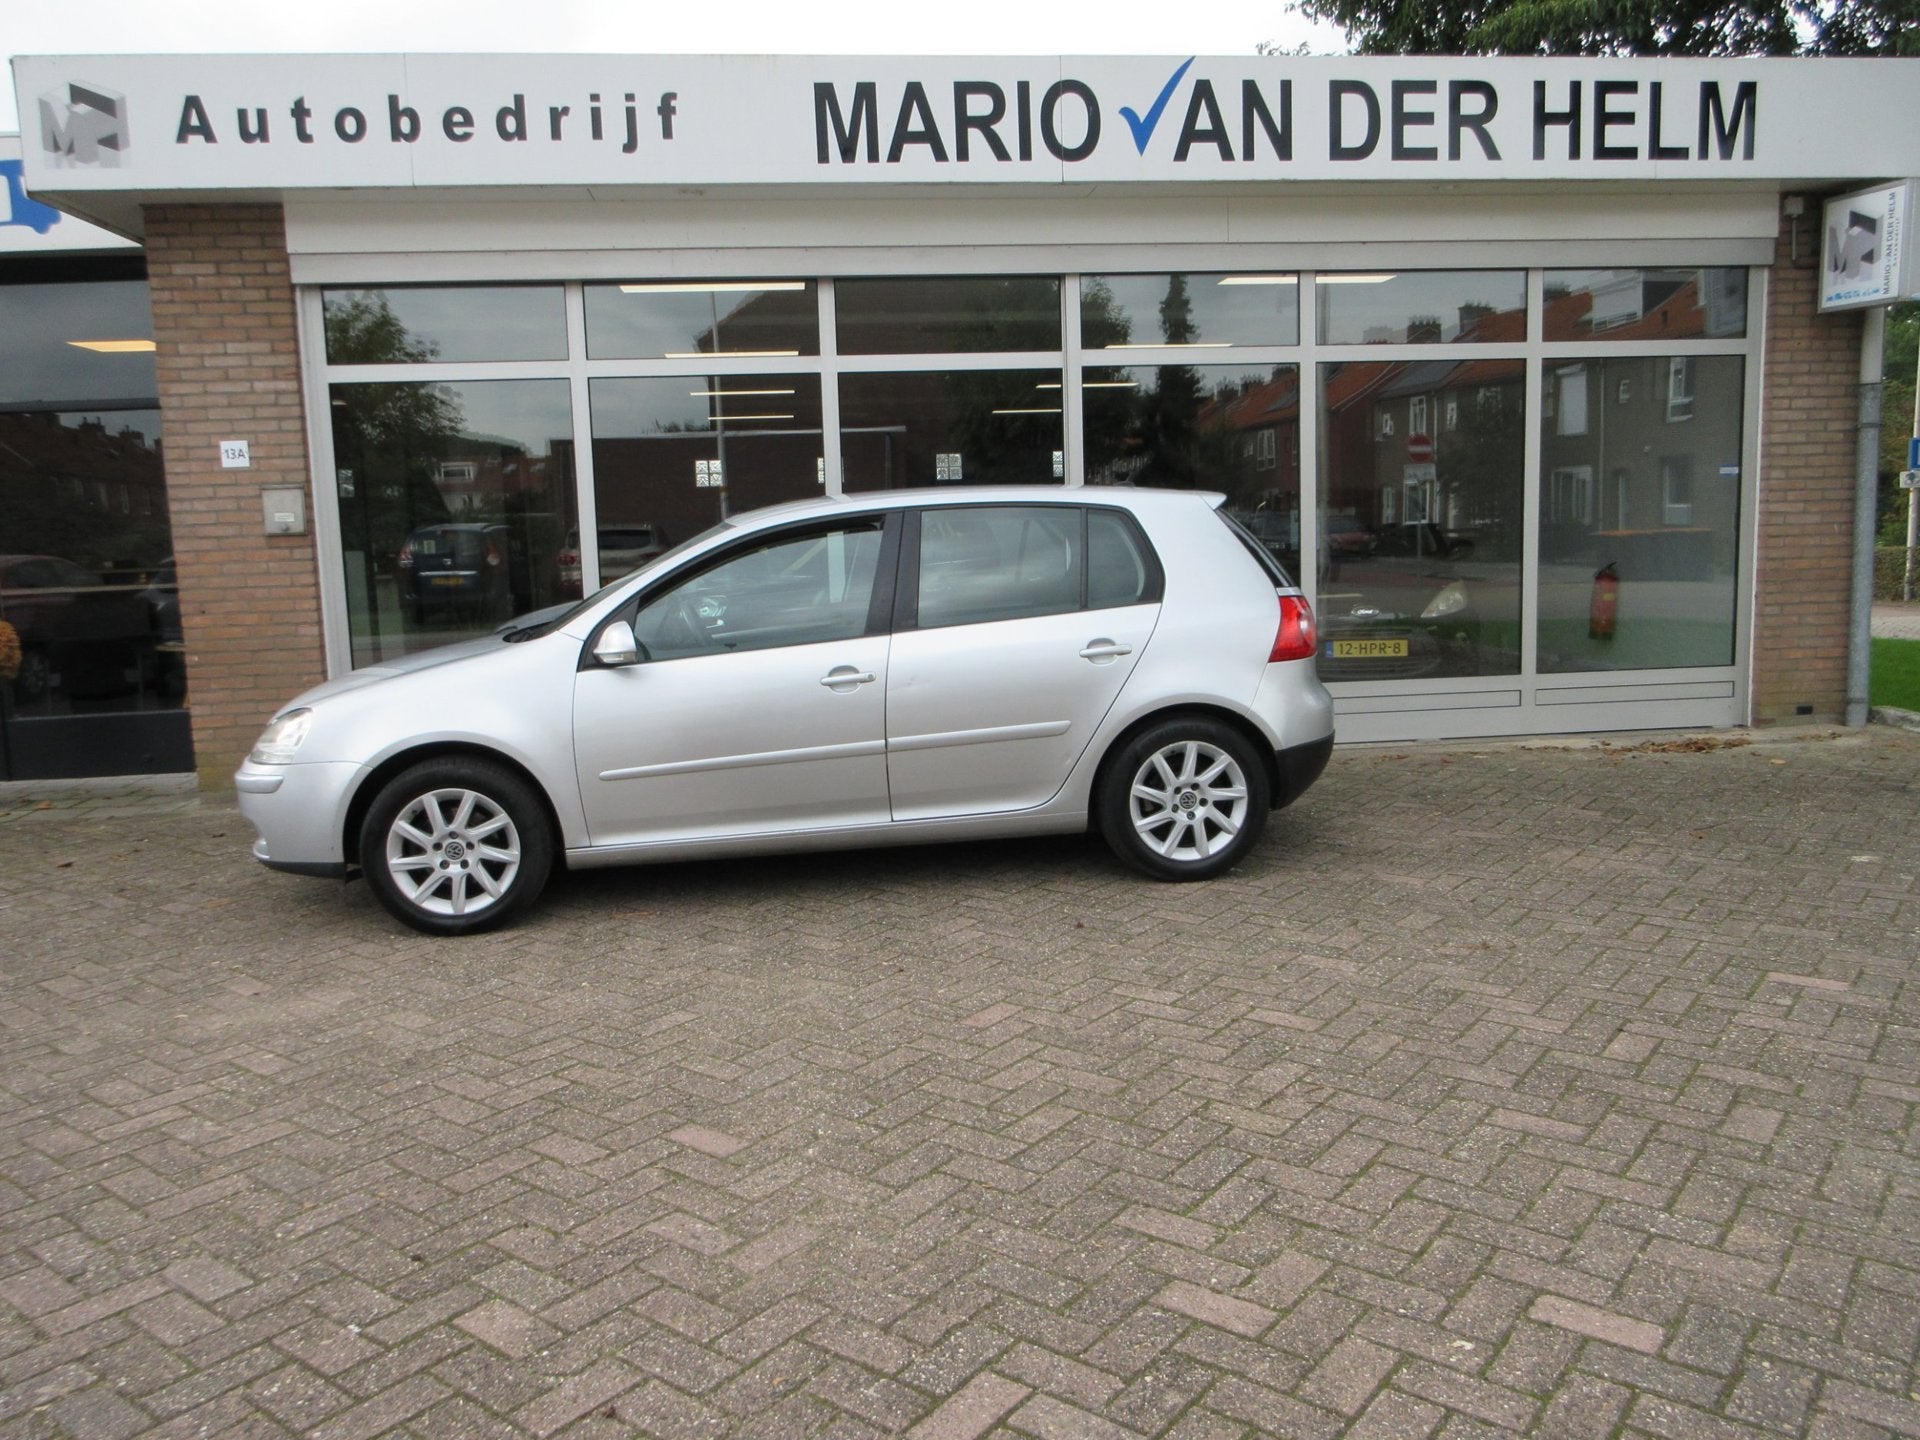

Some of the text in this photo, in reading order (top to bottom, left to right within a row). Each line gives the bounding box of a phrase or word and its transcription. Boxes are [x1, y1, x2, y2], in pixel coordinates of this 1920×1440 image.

[176, 93, 679, 153] Autobedrijf
[813, 79, 1102, 164] MARIO
[1328, 79, 1502, 161] DER
[1532, 80, 1758, 161] HELM
[1883, 264, 1891, 295] MARIO
[1888, 191, 1896, 219] HELM
[225, 448, 246, 459] 13A
[1339, 642, 1401, 655] 12-HPR-8
